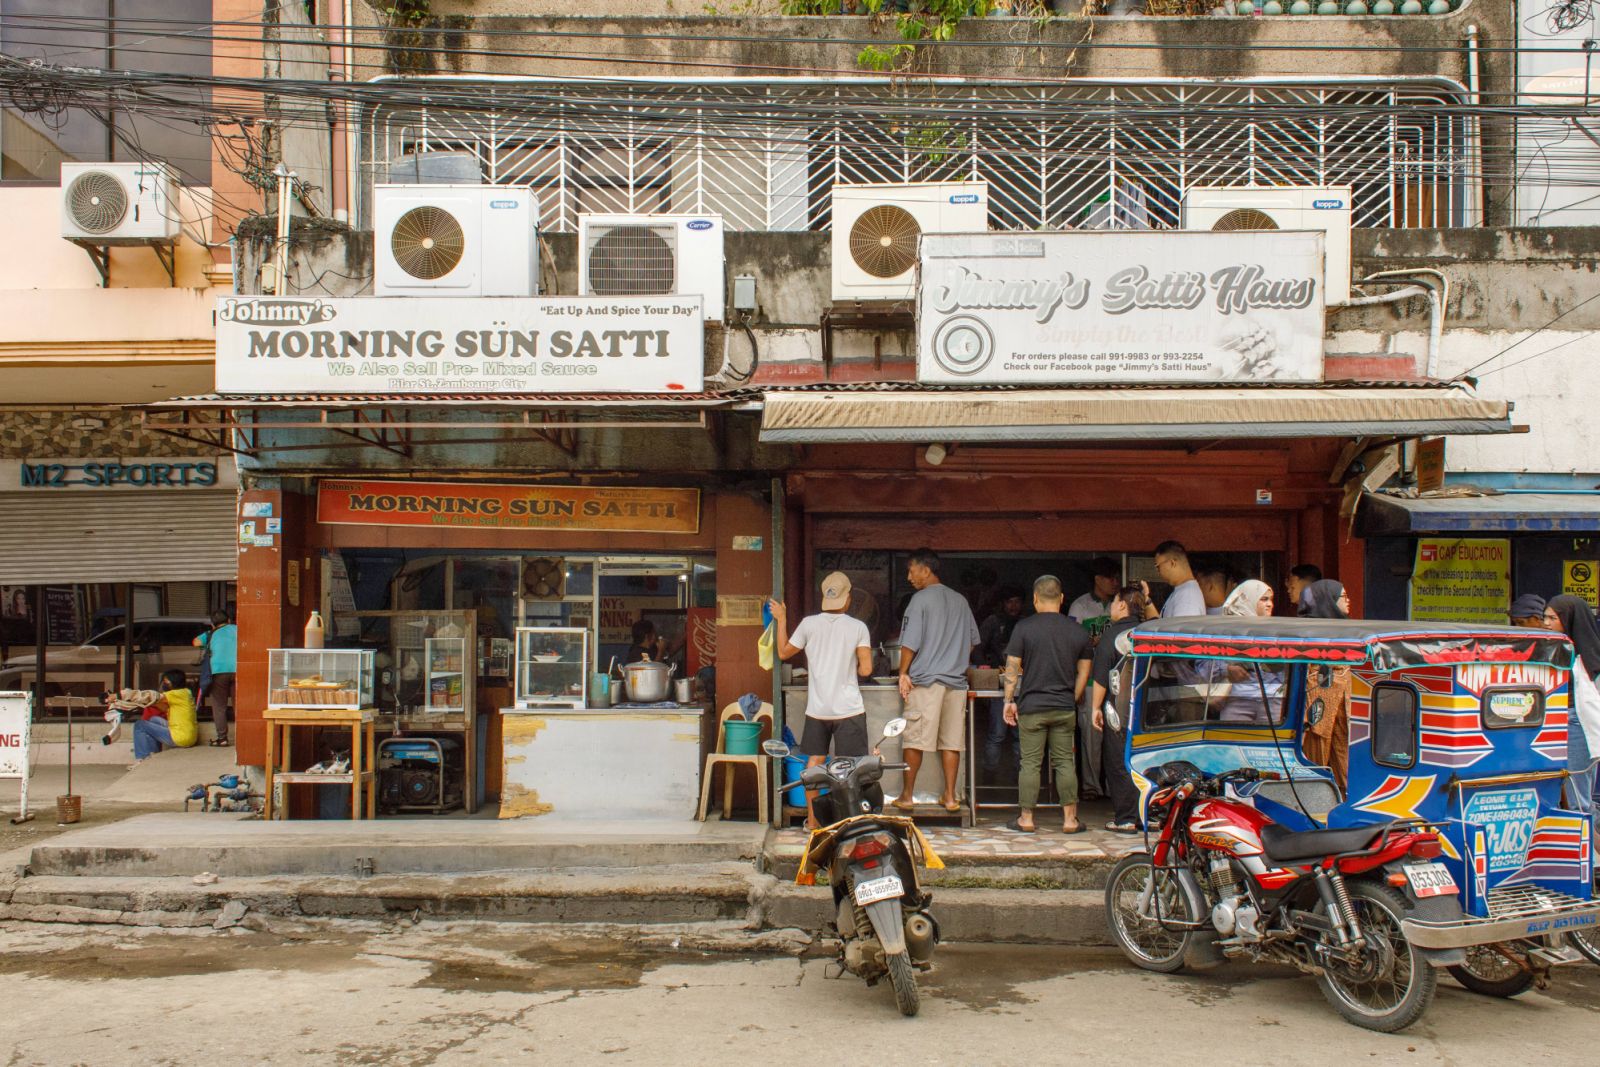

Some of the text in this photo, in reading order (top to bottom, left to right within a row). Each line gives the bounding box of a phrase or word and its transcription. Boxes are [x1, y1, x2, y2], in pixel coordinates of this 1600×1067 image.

[932, 263, 1315, 324] Jimmy's Satti Haus
[220, 299, 337, 326] Johnny's
[567, 306, 583, 317] Up
[585, 306, 608, 315] And
[611, 306, 640, 317] Spice
[642, 306, 670, 315] Your
[248, 330, 445, 358] MORNING
[549, 330, 670, 358] SATTI
[1012, 352, 1026, 360] For
[1028, 352, 1056, 360] orders
[1059, 352, 1088, 362] please
[1090, 352, 1107, 360] call
[1109, 352, 1149, 360] 991-9983
[1163, 352, 1204, 360] 993-2254
[327, 362, 355, 376] We
[358, 362, 399, 376] Also
[403, 362, 438, 376] Sell
[482, 362, 537, 376] Mixed
[541, 362, 598, 376] Sauce
[1003, 362, 1031, 370] Check
[1050, 362, 1092, 370] Facebook
[1095, 363, 1117, 372] page
[1161, 362, 1182, 370] Satti
[389, 378, 416, 388] Pilar
[501, 379, 527, 389] City
[20, 462, 217, 487] M2 SPORTS
[349, 493, 678, 518] MORNING SUN SATTI
[432, 514, 448, 523] We
[1458, 546, 1503, 560] EDUCATION
[1410, 870, 1453, 888] 853JQS
